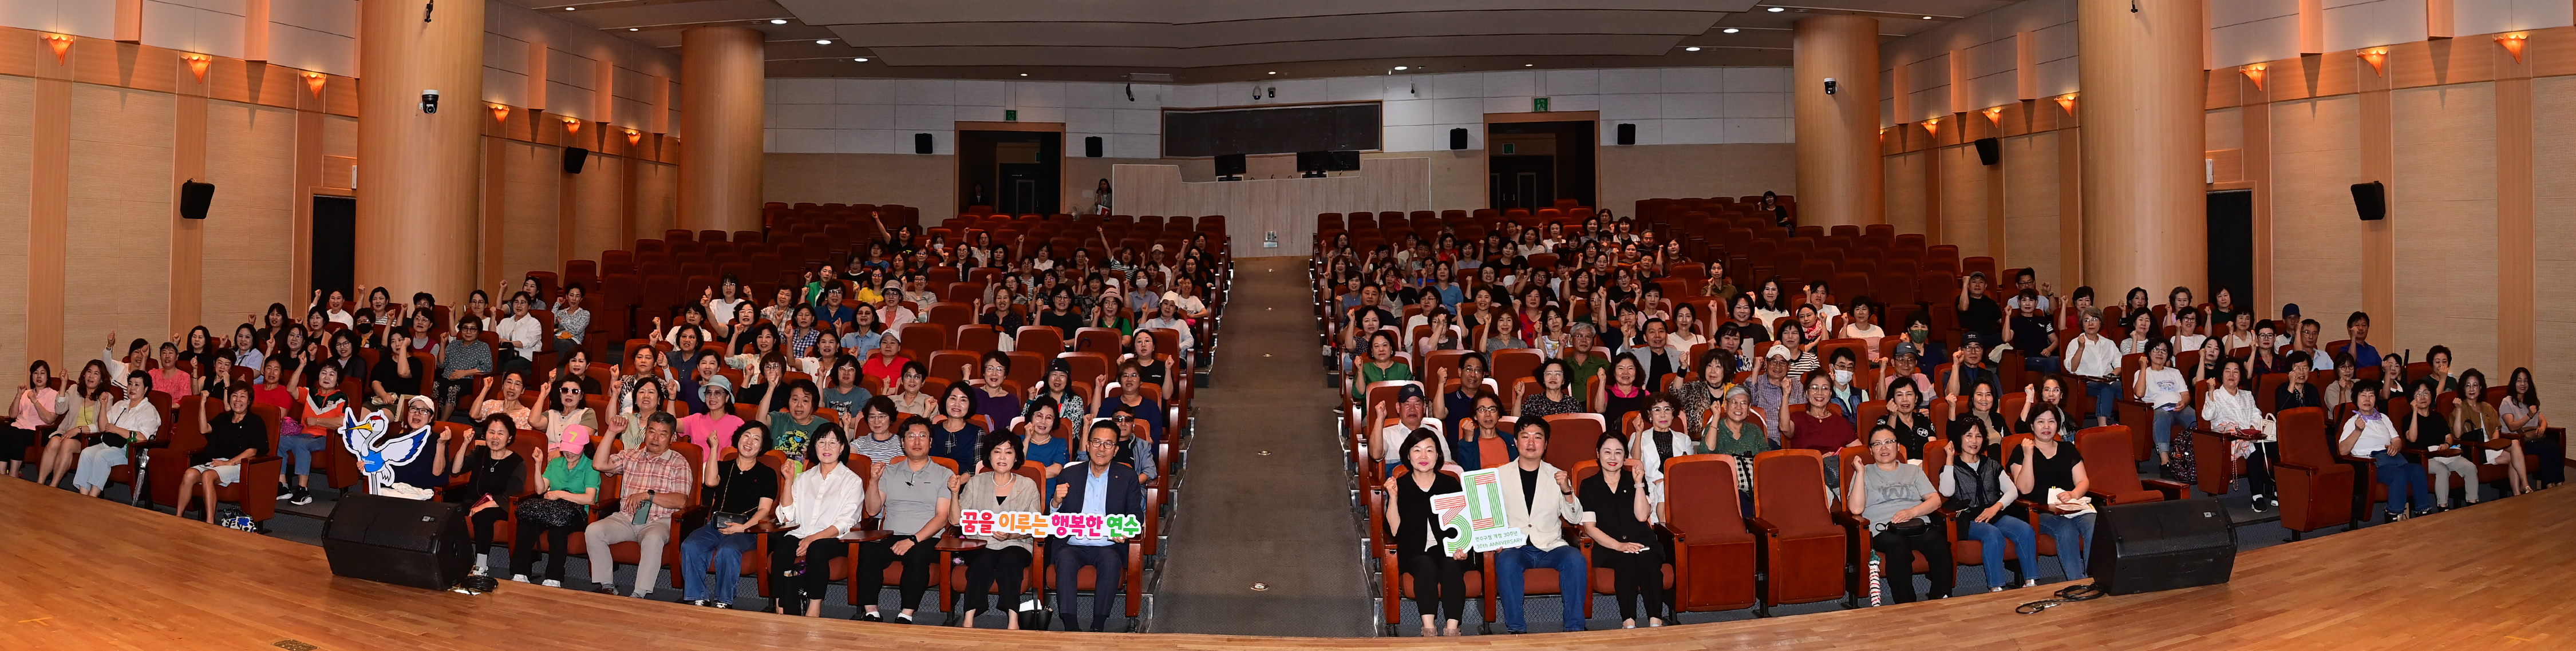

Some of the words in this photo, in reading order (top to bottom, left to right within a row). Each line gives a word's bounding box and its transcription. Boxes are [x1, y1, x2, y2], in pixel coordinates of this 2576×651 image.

[569, 431, 578, 443] 7
[1434, 471, 1504, 553] 30
[962, 512, 995, 534] 꿈을
[999, 513, 1048, 535] 이루는
[1052, 514, 1104, 537] 행복한
[1107, 516, 1139, 537] 연수
[1490, 538, 1523, 547] ANNIVERSARY
